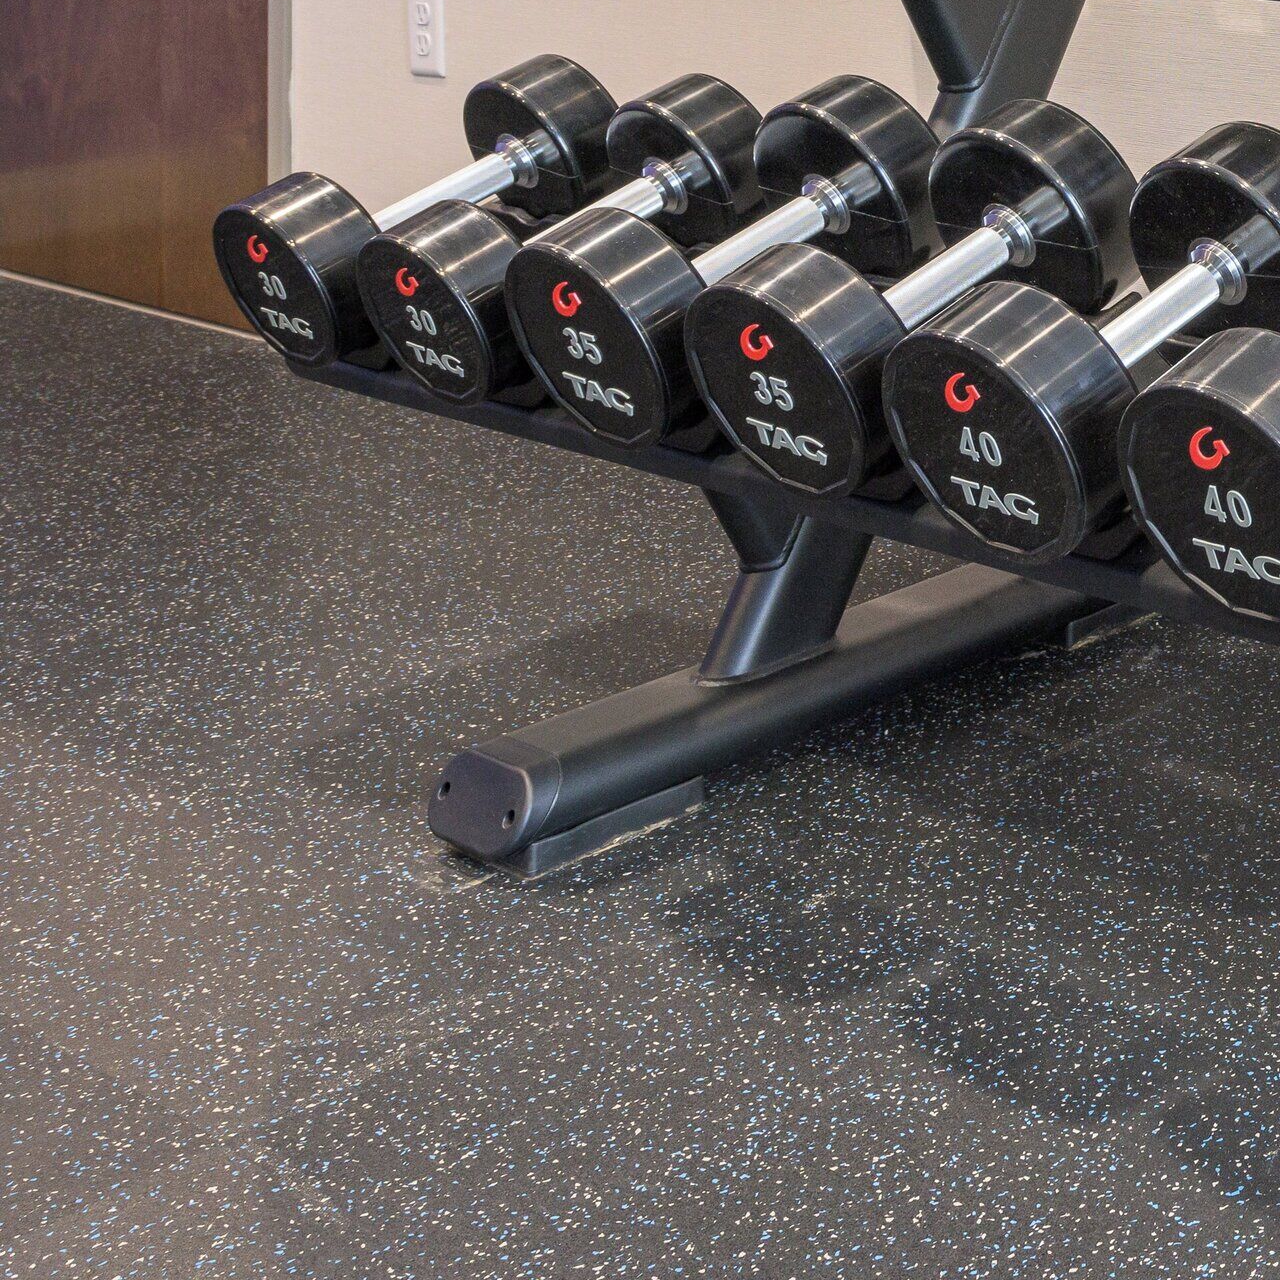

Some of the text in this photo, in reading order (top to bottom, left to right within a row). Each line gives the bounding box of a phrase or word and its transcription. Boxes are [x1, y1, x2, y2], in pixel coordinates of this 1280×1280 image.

[258, 271, 287, 300] 30
[259, 306, 314, 340] TAG
[405, 304, 438, 336] 30
[405, 341, 465, 378] TAG
[562, 326, 603, 365] 35
[561, 371, 634, 417] TAG
[749, 371, 794, 412] 35
[745, 416, 828, 466] TAG
[958, 425, 1003, 467] 40
[949, 475, 1039, 525] TAG
[1203, 484, 1253, 528] 40
